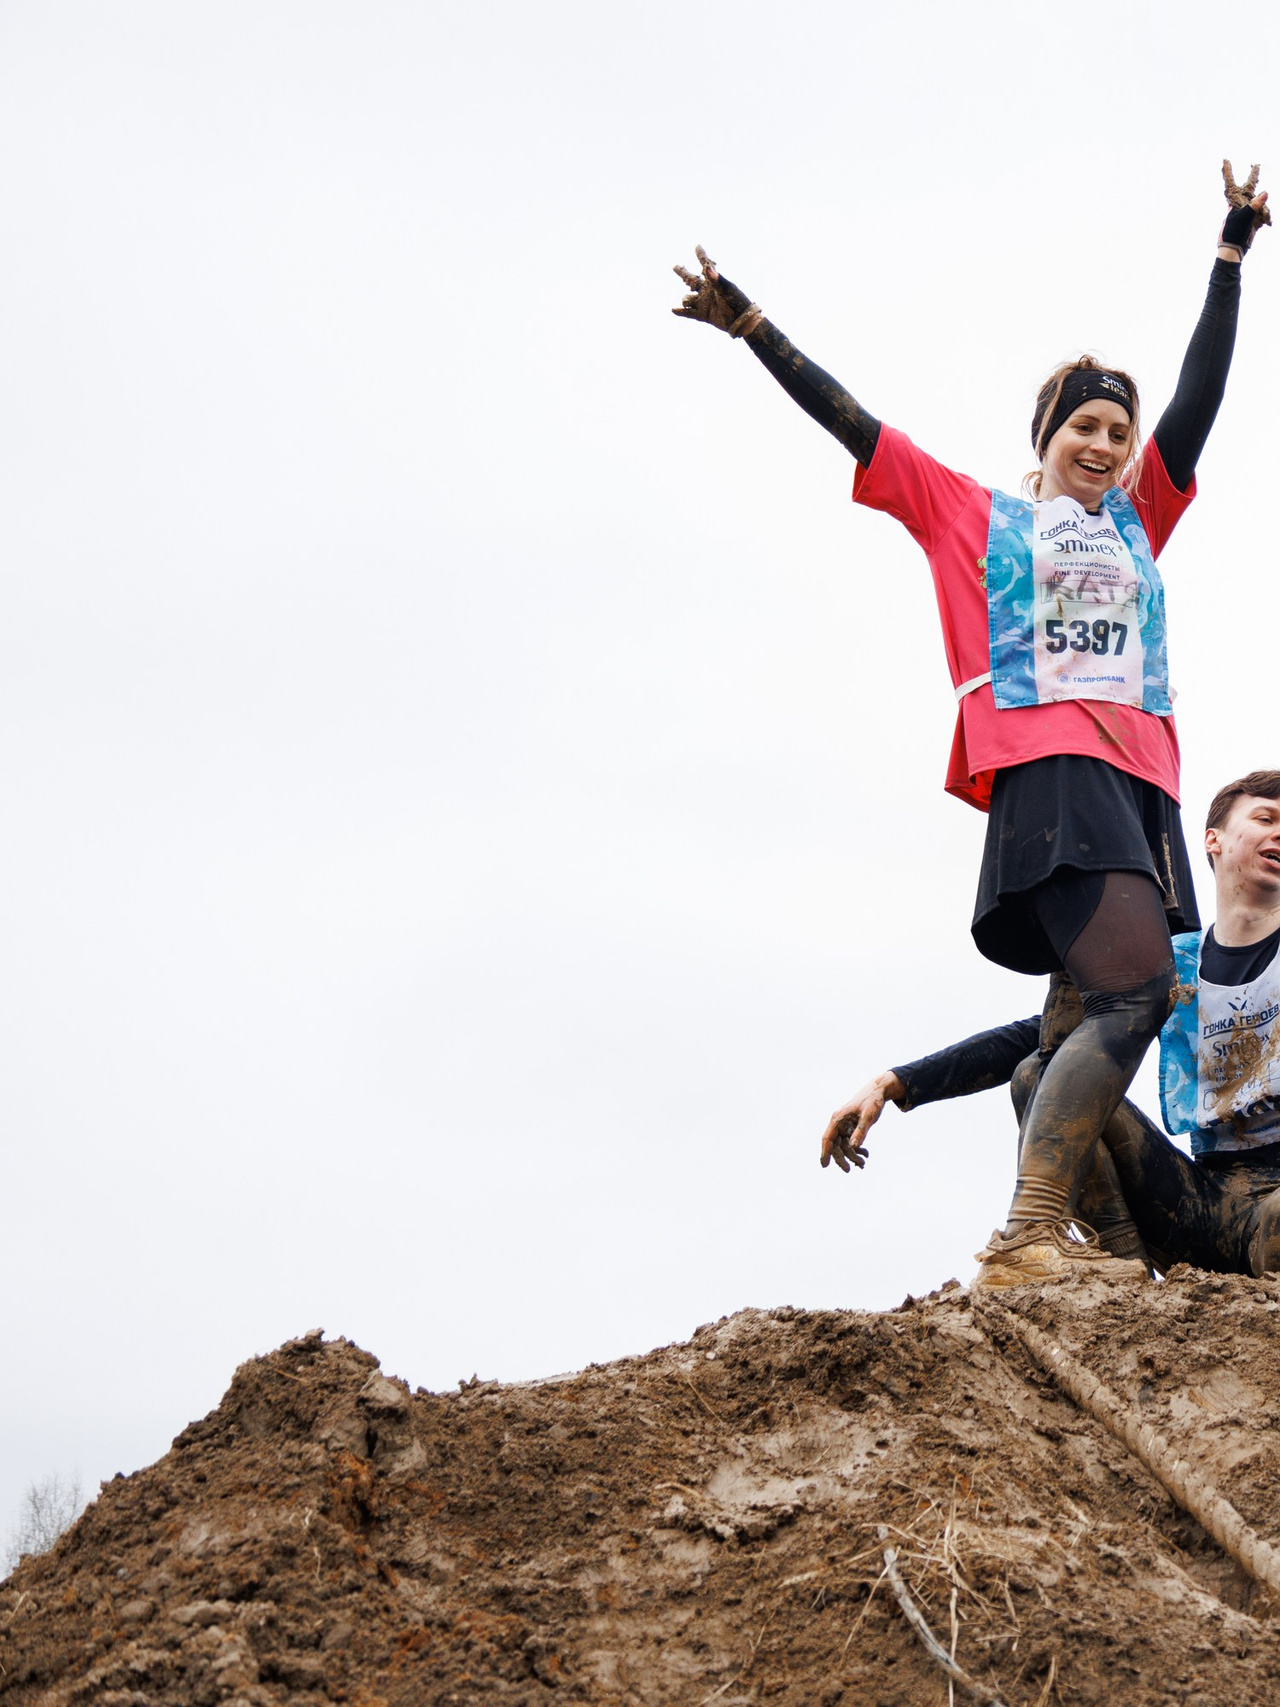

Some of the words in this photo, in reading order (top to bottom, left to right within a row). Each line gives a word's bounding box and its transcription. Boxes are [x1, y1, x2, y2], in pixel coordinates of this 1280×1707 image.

[1040, 520, 1079, 538] ГОНКА
[1080, 526, 1119, 539] ГЕРОЕВ
[1054, 561, 1121, 572] ПЕРФЕКЦИОНИСТЫ
[1074, 569, 1121, 580] DEVELOPMENT
[1045, 619, 1128, 656] 5397
[1073, 675, 1126, 684] ГАЗПРОМБАНК
[1203, 1017, 1236, 1036] ГОНКА
